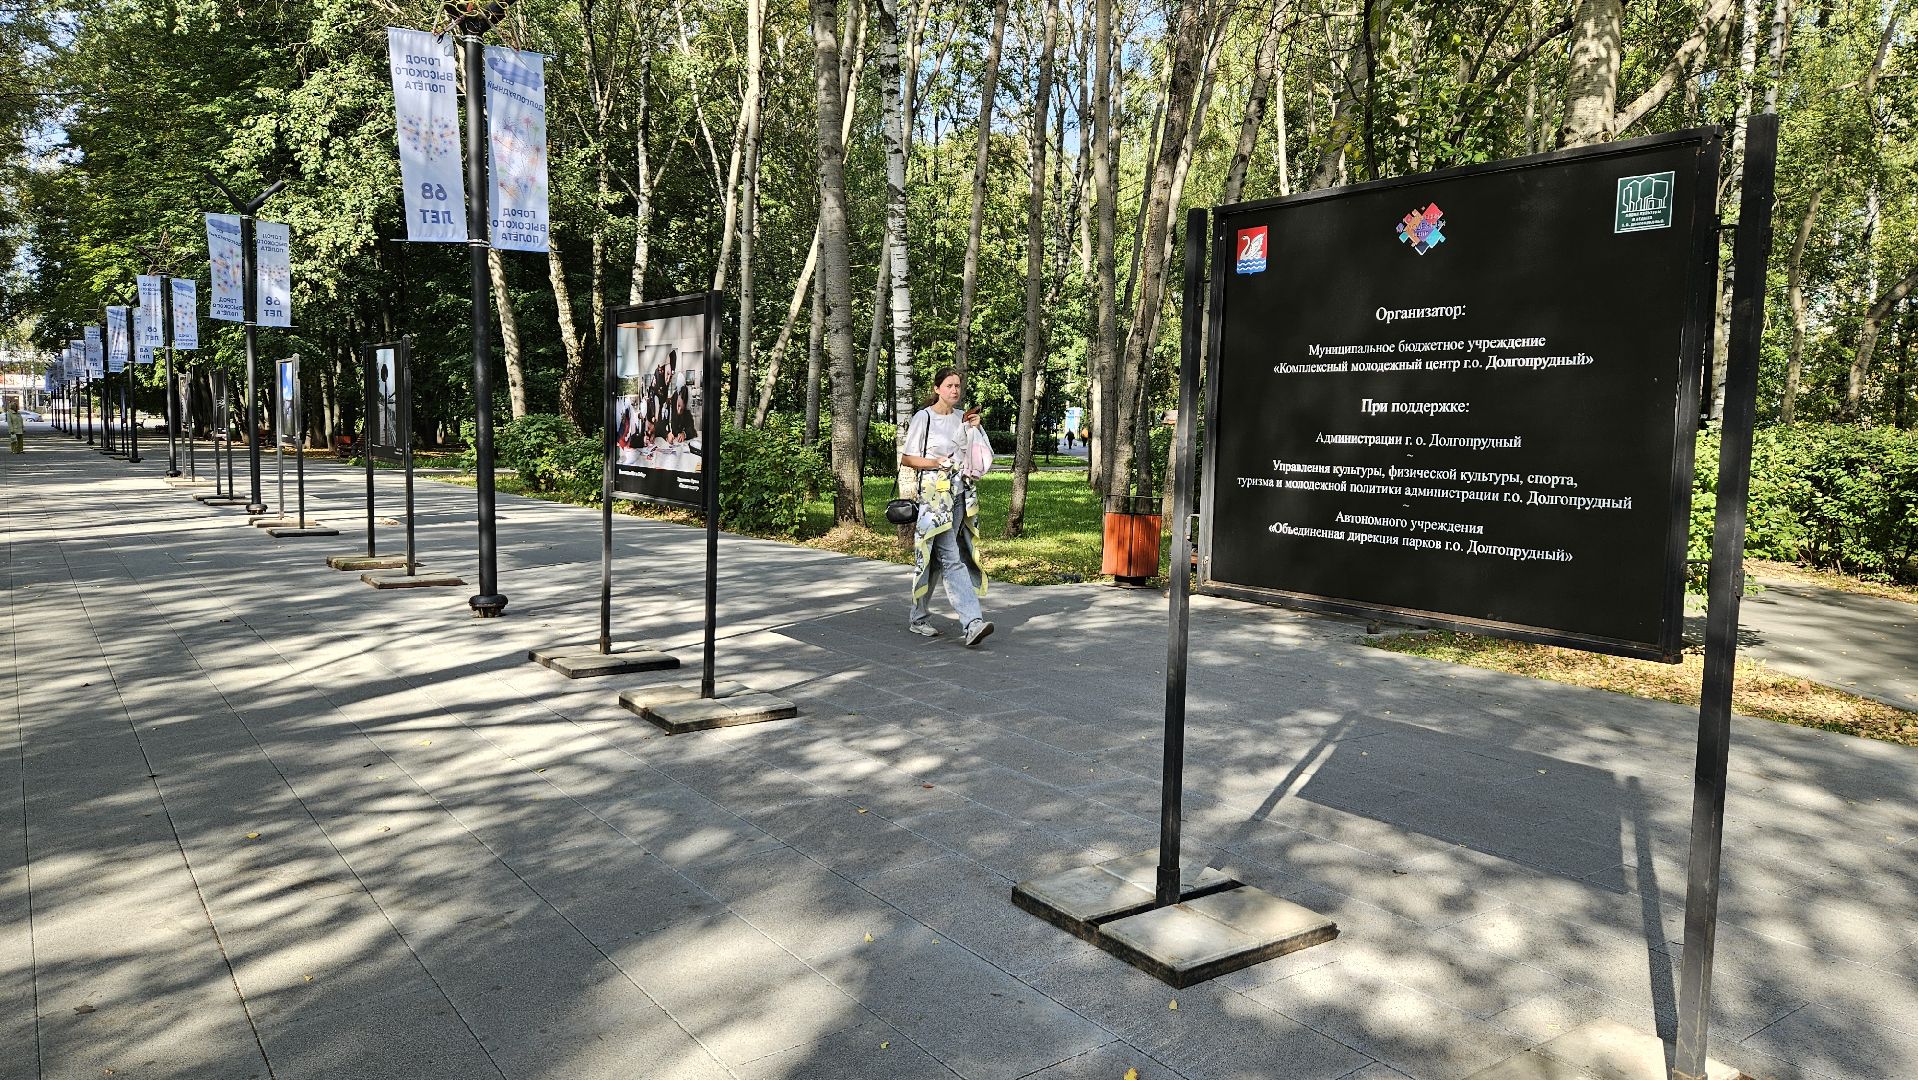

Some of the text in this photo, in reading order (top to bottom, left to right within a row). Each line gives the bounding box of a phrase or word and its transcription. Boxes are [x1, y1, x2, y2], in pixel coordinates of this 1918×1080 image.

[1375, 304, 1467, 324] Организатор:
[1308, 336, 1547, 358] Муниципальное бюджетное учреждение
[1273, 352, 1594, 374] «Комплексный молодежный центр г.о. Долгопрудный»
[1360, 398, 1470, 417] При поддержке:
[1314, 431, 1403, 447] Администрации
[1428, 433, 1522, 451] Долгопрудный
[1272, 459, 1578, 489] Управления культуры, физической культуры, спорта,
[1236, 476, 1633, 511] туризма и молодежной политики администрации г.о. Долгопрудный
[1334, 510, 1484, 535] Автономного учреждения
[1268, 521, 1574, 562] «Объединенная дирекция парков г.о. Долгопрудный»
